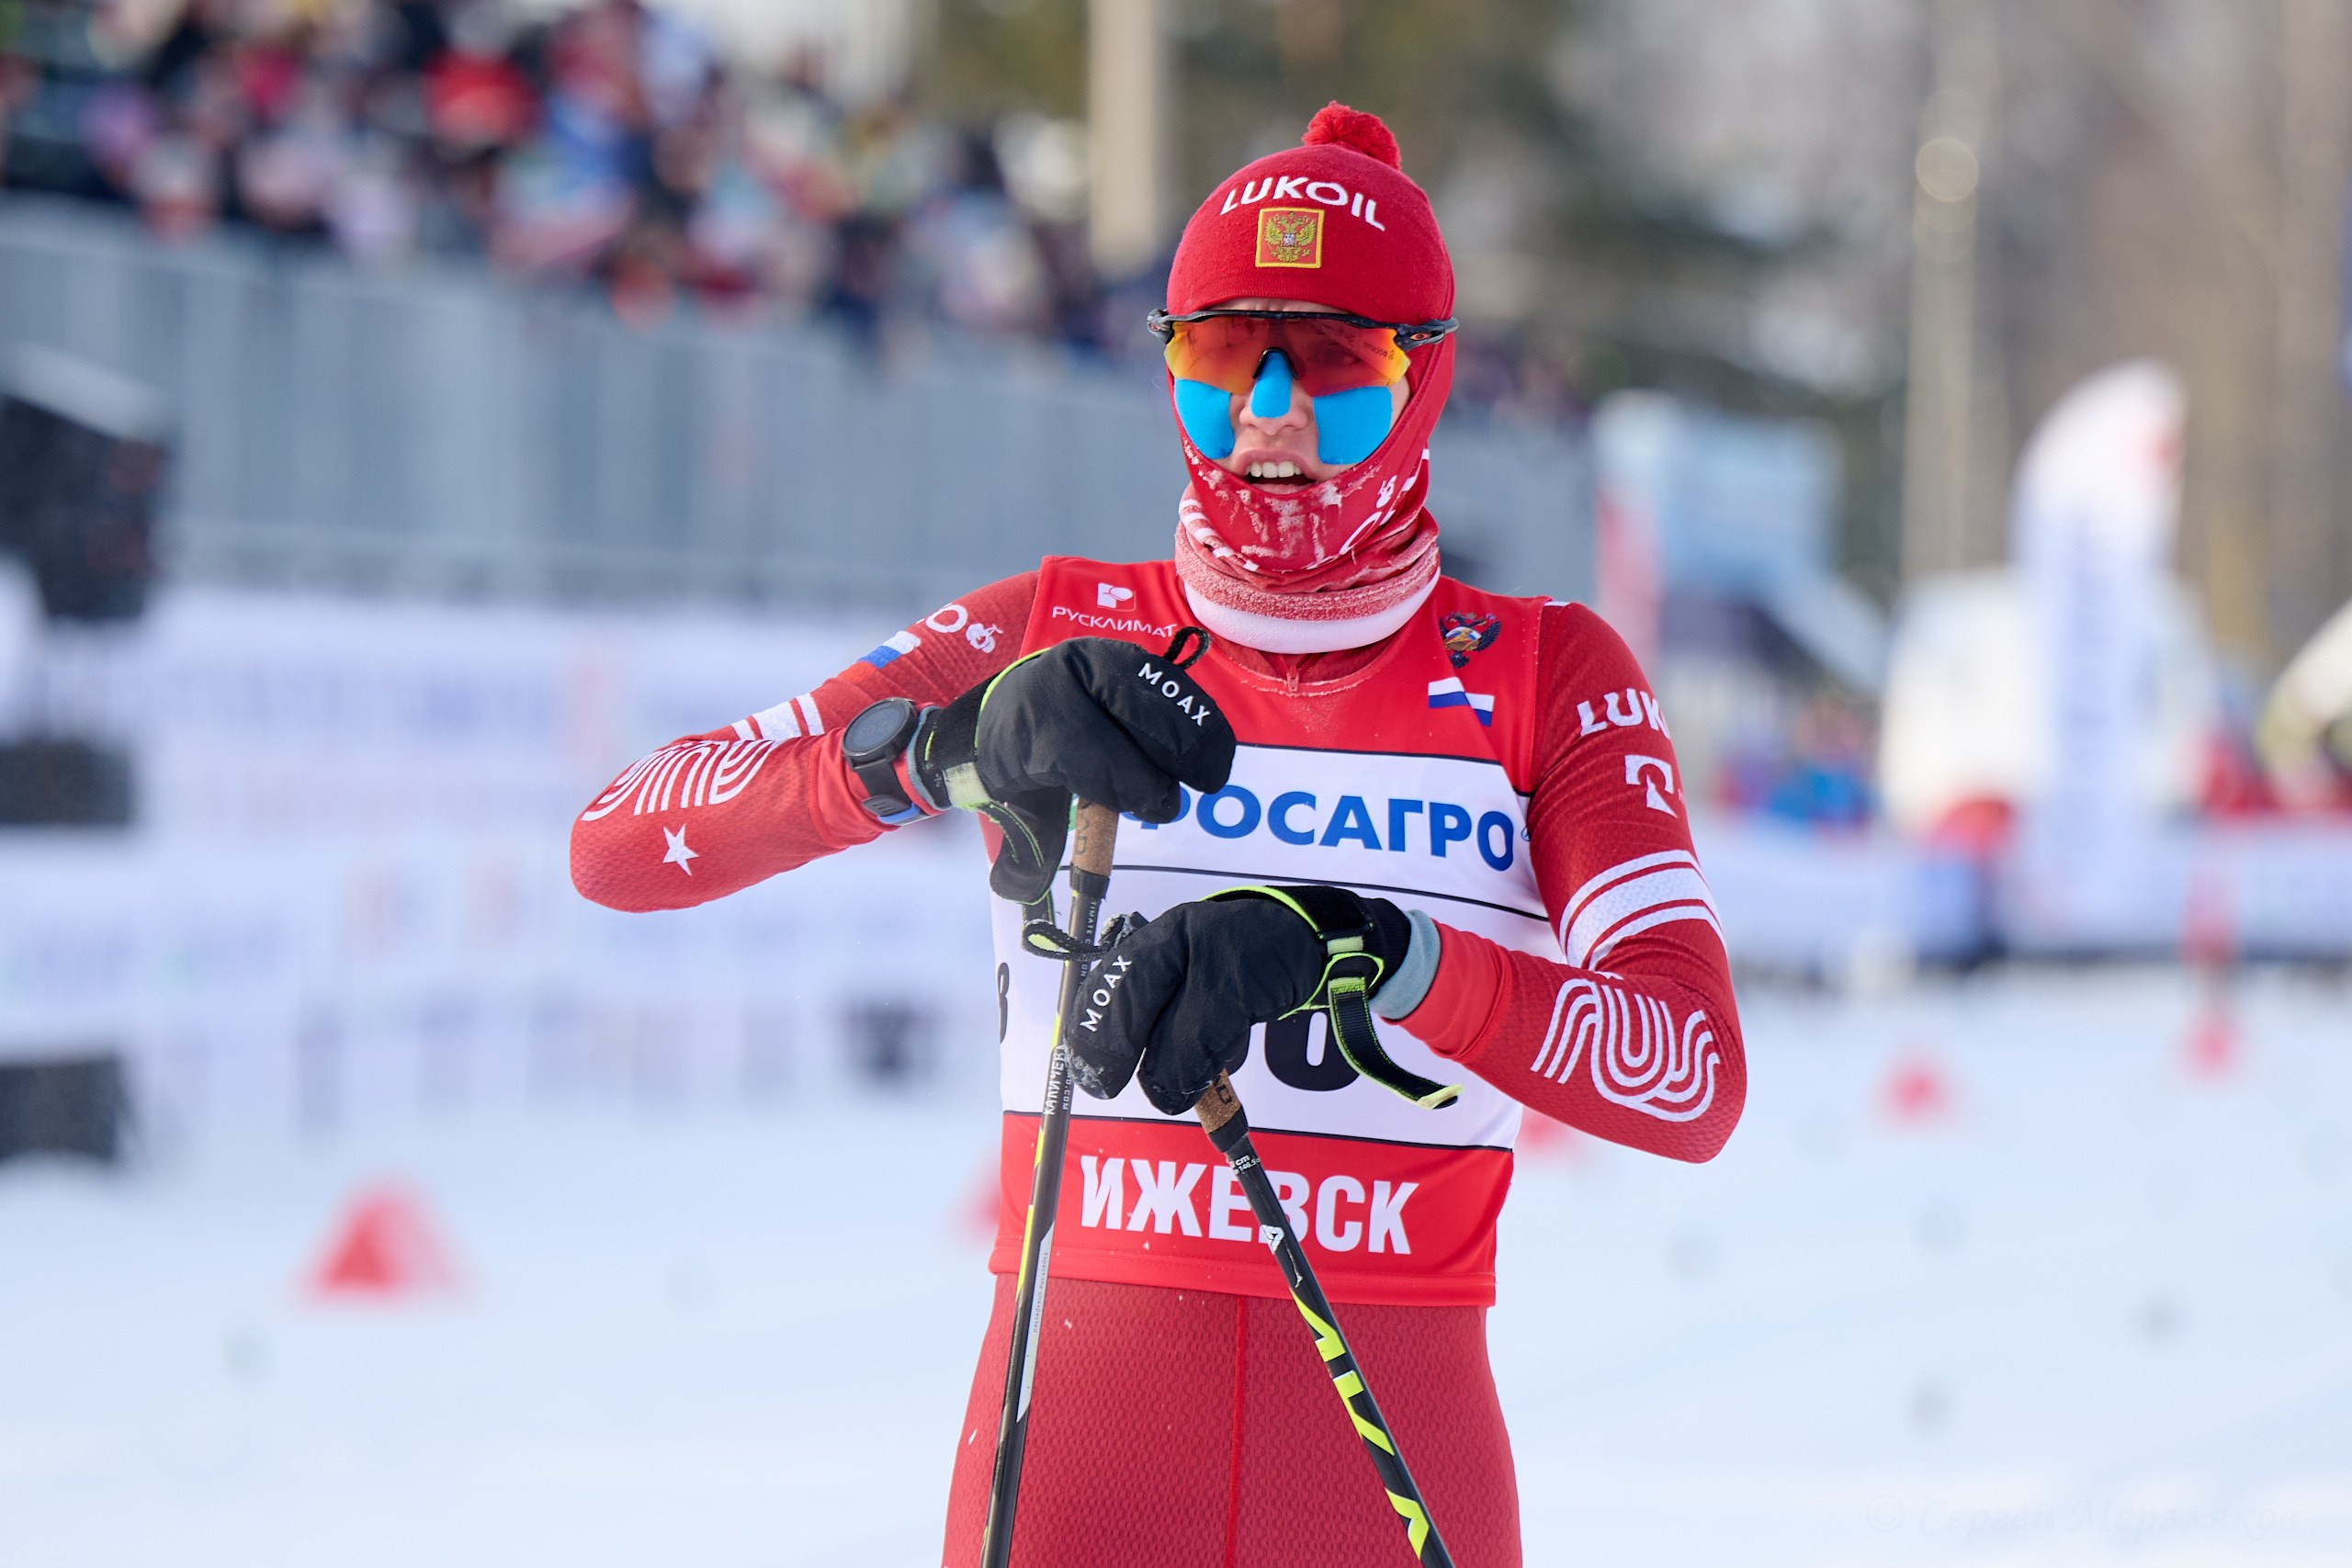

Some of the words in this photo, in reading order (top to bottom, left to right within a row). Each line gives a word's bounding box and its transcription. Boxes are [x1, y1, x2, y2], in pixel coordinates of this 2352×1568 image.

[1220, 175, 1386, 231] LUKOIL
[1052, 606, 1177, 638] РУСКЛИМАТ
[1137, 662, 1211, 727] MOAX
[1576, 688, 1670, 739] LUK
[1085, 901, 1097, 934] TIMATE
[1080, 954, 1133, 1032] MOAX
[1080, 1155, 1419, 1255] ИЖЕВСК
